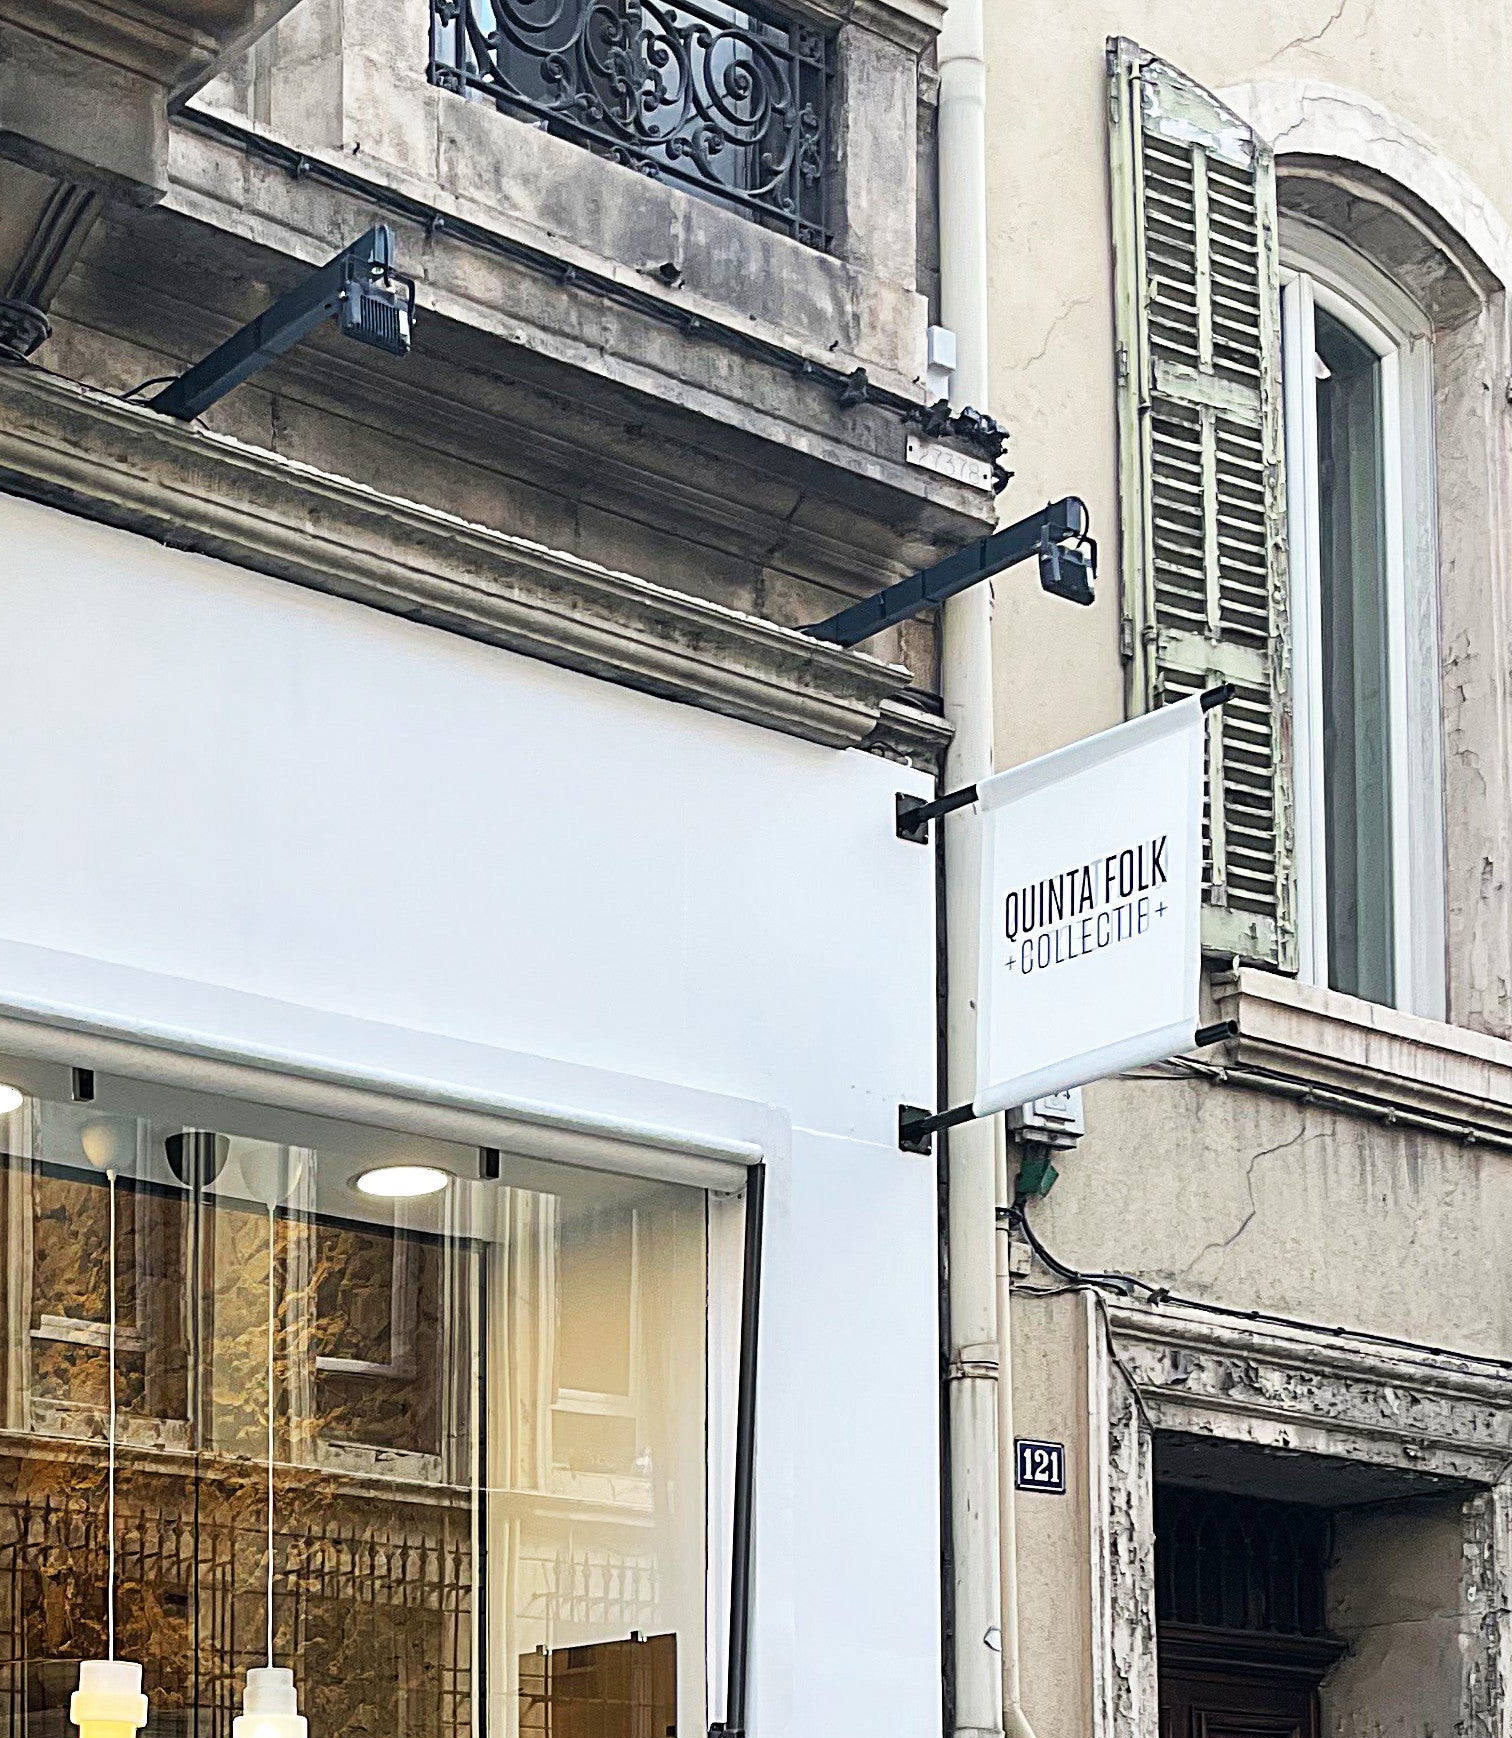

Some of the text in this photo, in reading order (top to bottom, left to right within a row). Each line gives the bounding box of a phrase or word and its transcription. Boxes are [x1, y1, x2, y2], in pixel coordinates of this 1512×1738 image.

[1005, 836, 1169, 942] QUINTA FOLK
[1023, 1448, 1060, 1483] 121
